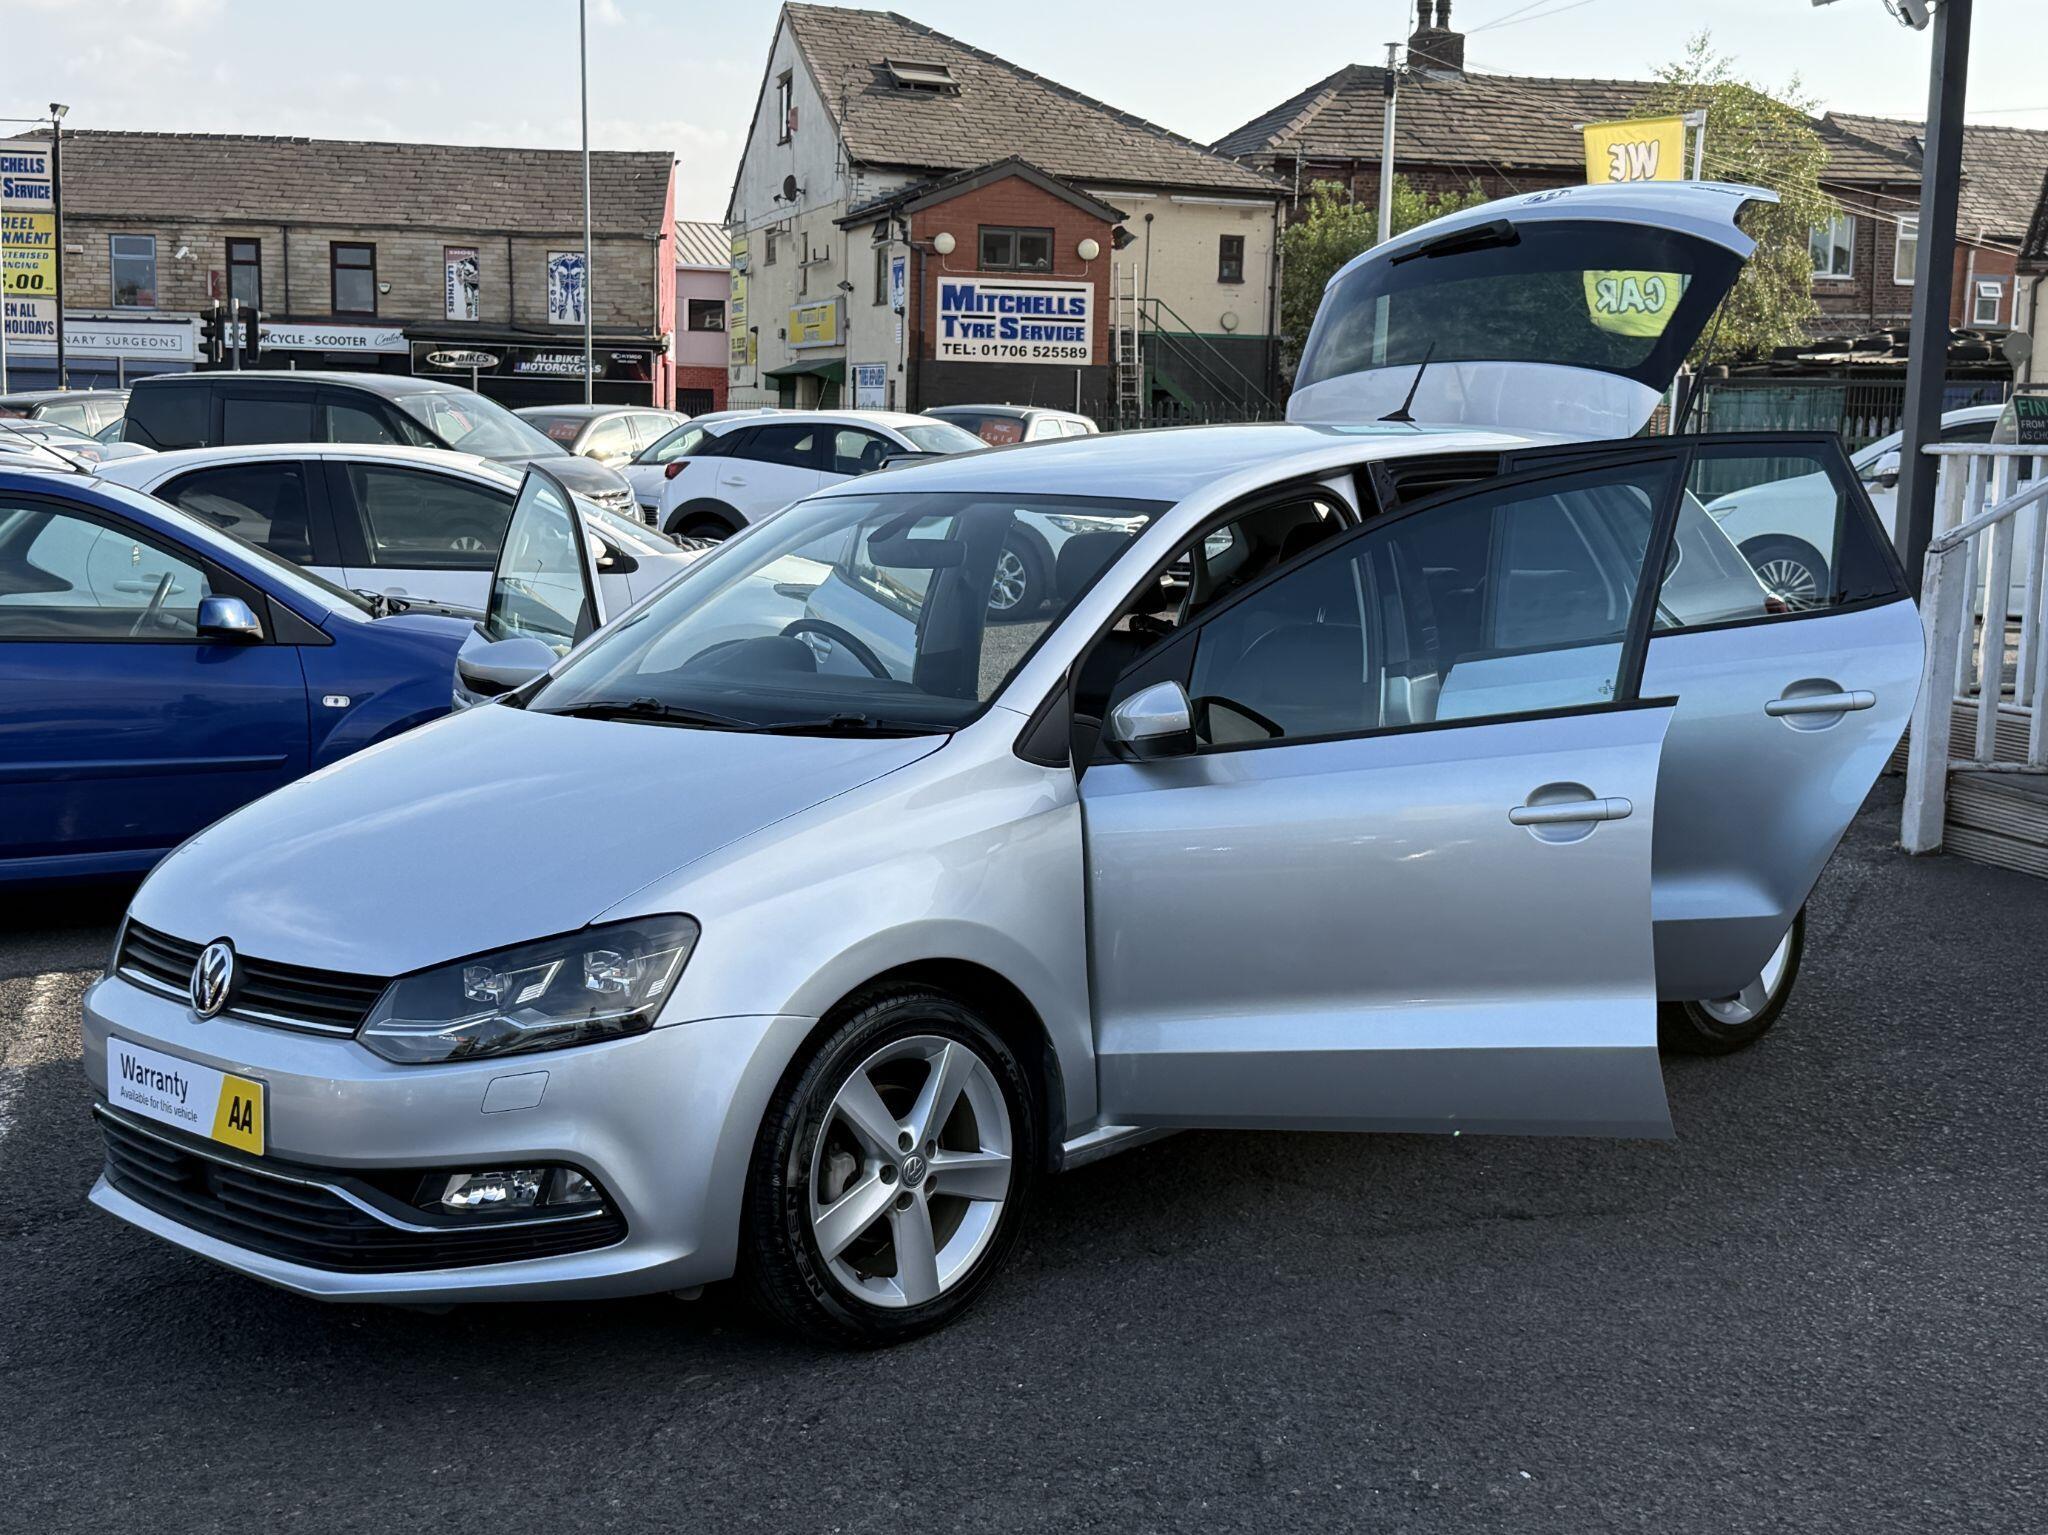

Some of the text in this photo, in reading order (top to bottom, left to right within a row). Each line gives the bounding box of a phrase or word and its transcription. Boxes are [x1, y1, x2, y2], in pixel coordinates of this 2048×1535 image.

[3, 177, 50, 199] SERVICE
[447, 265, 455, 314] LEATHERS
[941, 284, 1086, 316] MITCHELLS
[20, 303, 37, 318] ALL
[5, 320, 55, 335] HOLIDAYS
[941, 314, 1086, 342] TYRE SERVICE
[105, 336, 177, 348] SURGEONS
[315, 336, 367, 347] SCOOTER
[942, 343, 1088, 359] TEL: 01706 525589
[457, 353, 490, 363] BIKES
[2021, 419, 2045, 429] FROM
[120, 1052, 189, 1104] Warranty
[120, 1085, 199, 1123] Available for this vehicle
[228, 1095, 253, 1135] AA
